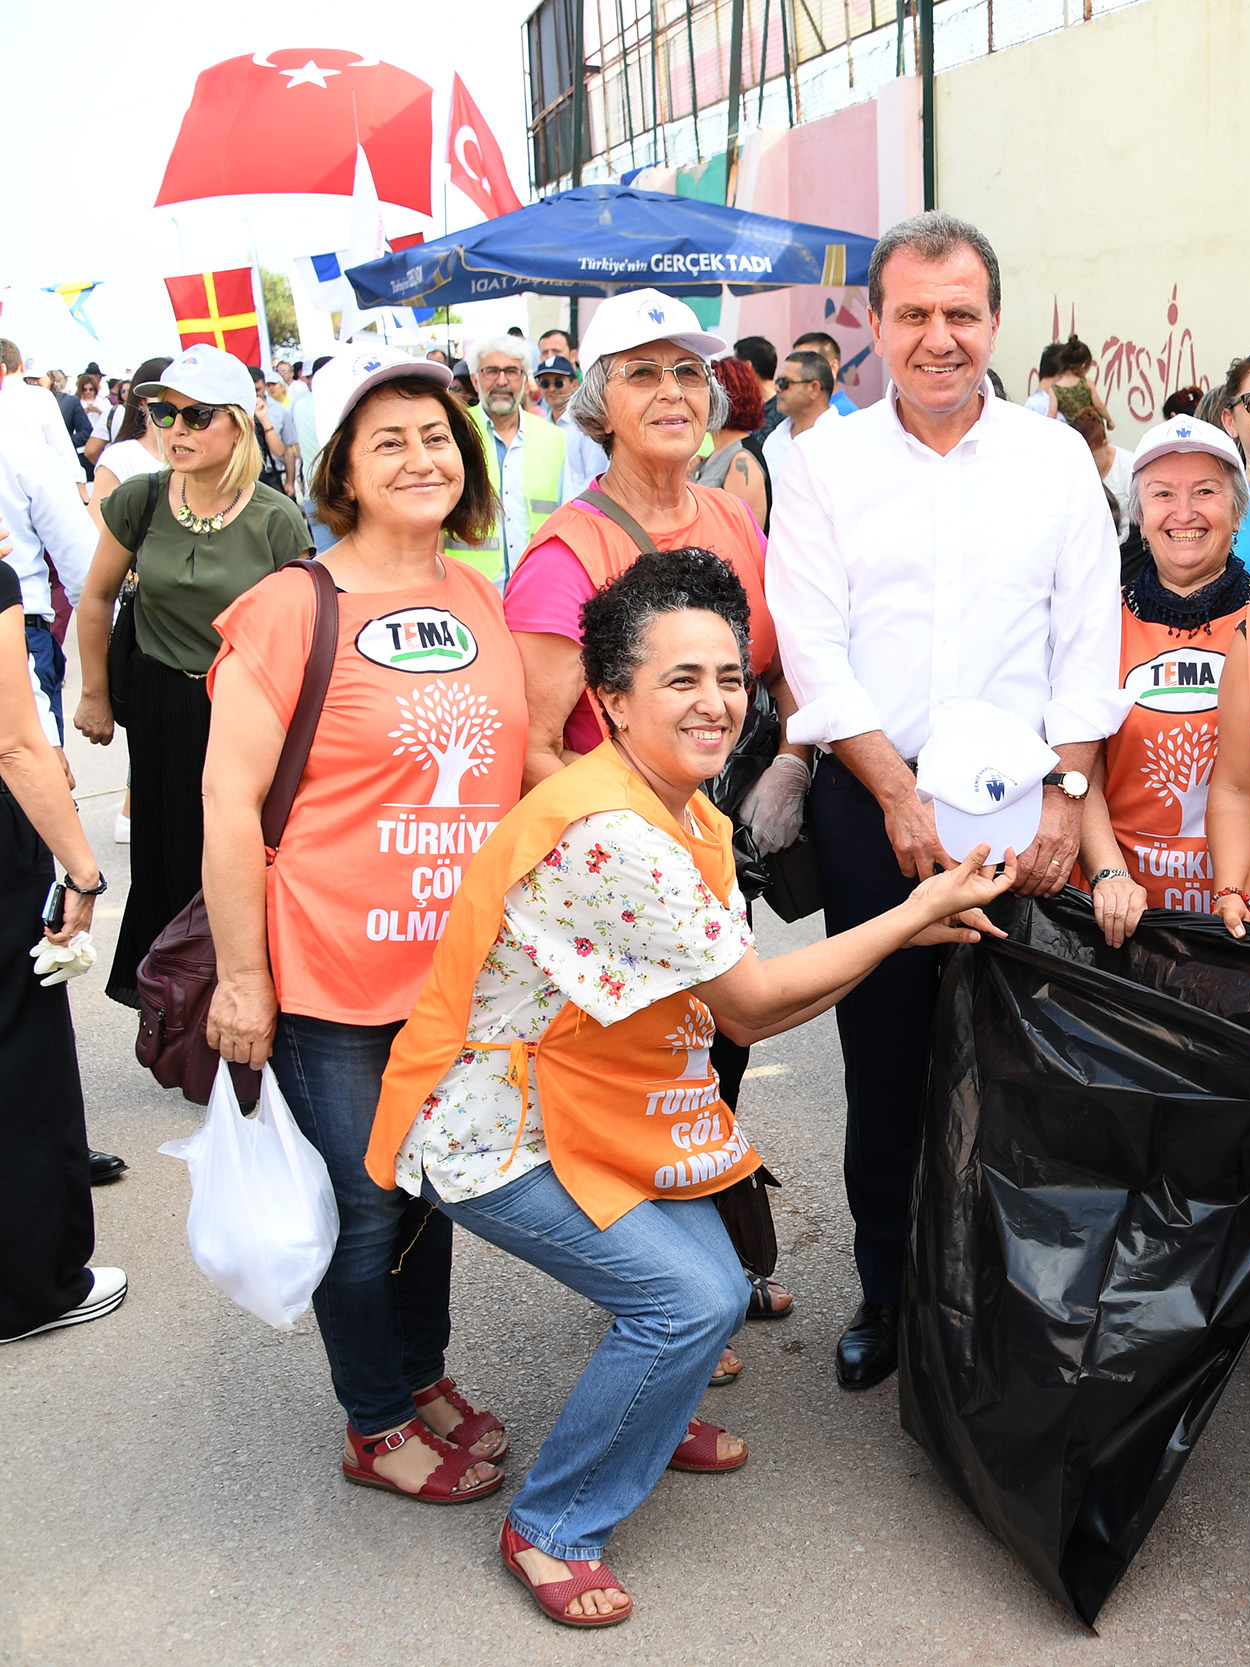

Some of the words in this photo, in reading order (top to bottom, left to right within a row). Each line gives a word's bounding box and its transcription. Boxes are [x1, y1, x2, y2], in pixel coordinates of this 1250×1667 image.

[578, 257, 648, 276] Türkiye'nin
[650, 253, 725, 277] GERÇEK
[726, 254, 772, 273] TADI
[386, 621, 455, 650] TEMA
[1151, 662, 1215, 686] TEMA
[670, 1110, 724, 1152] ÇÖL
